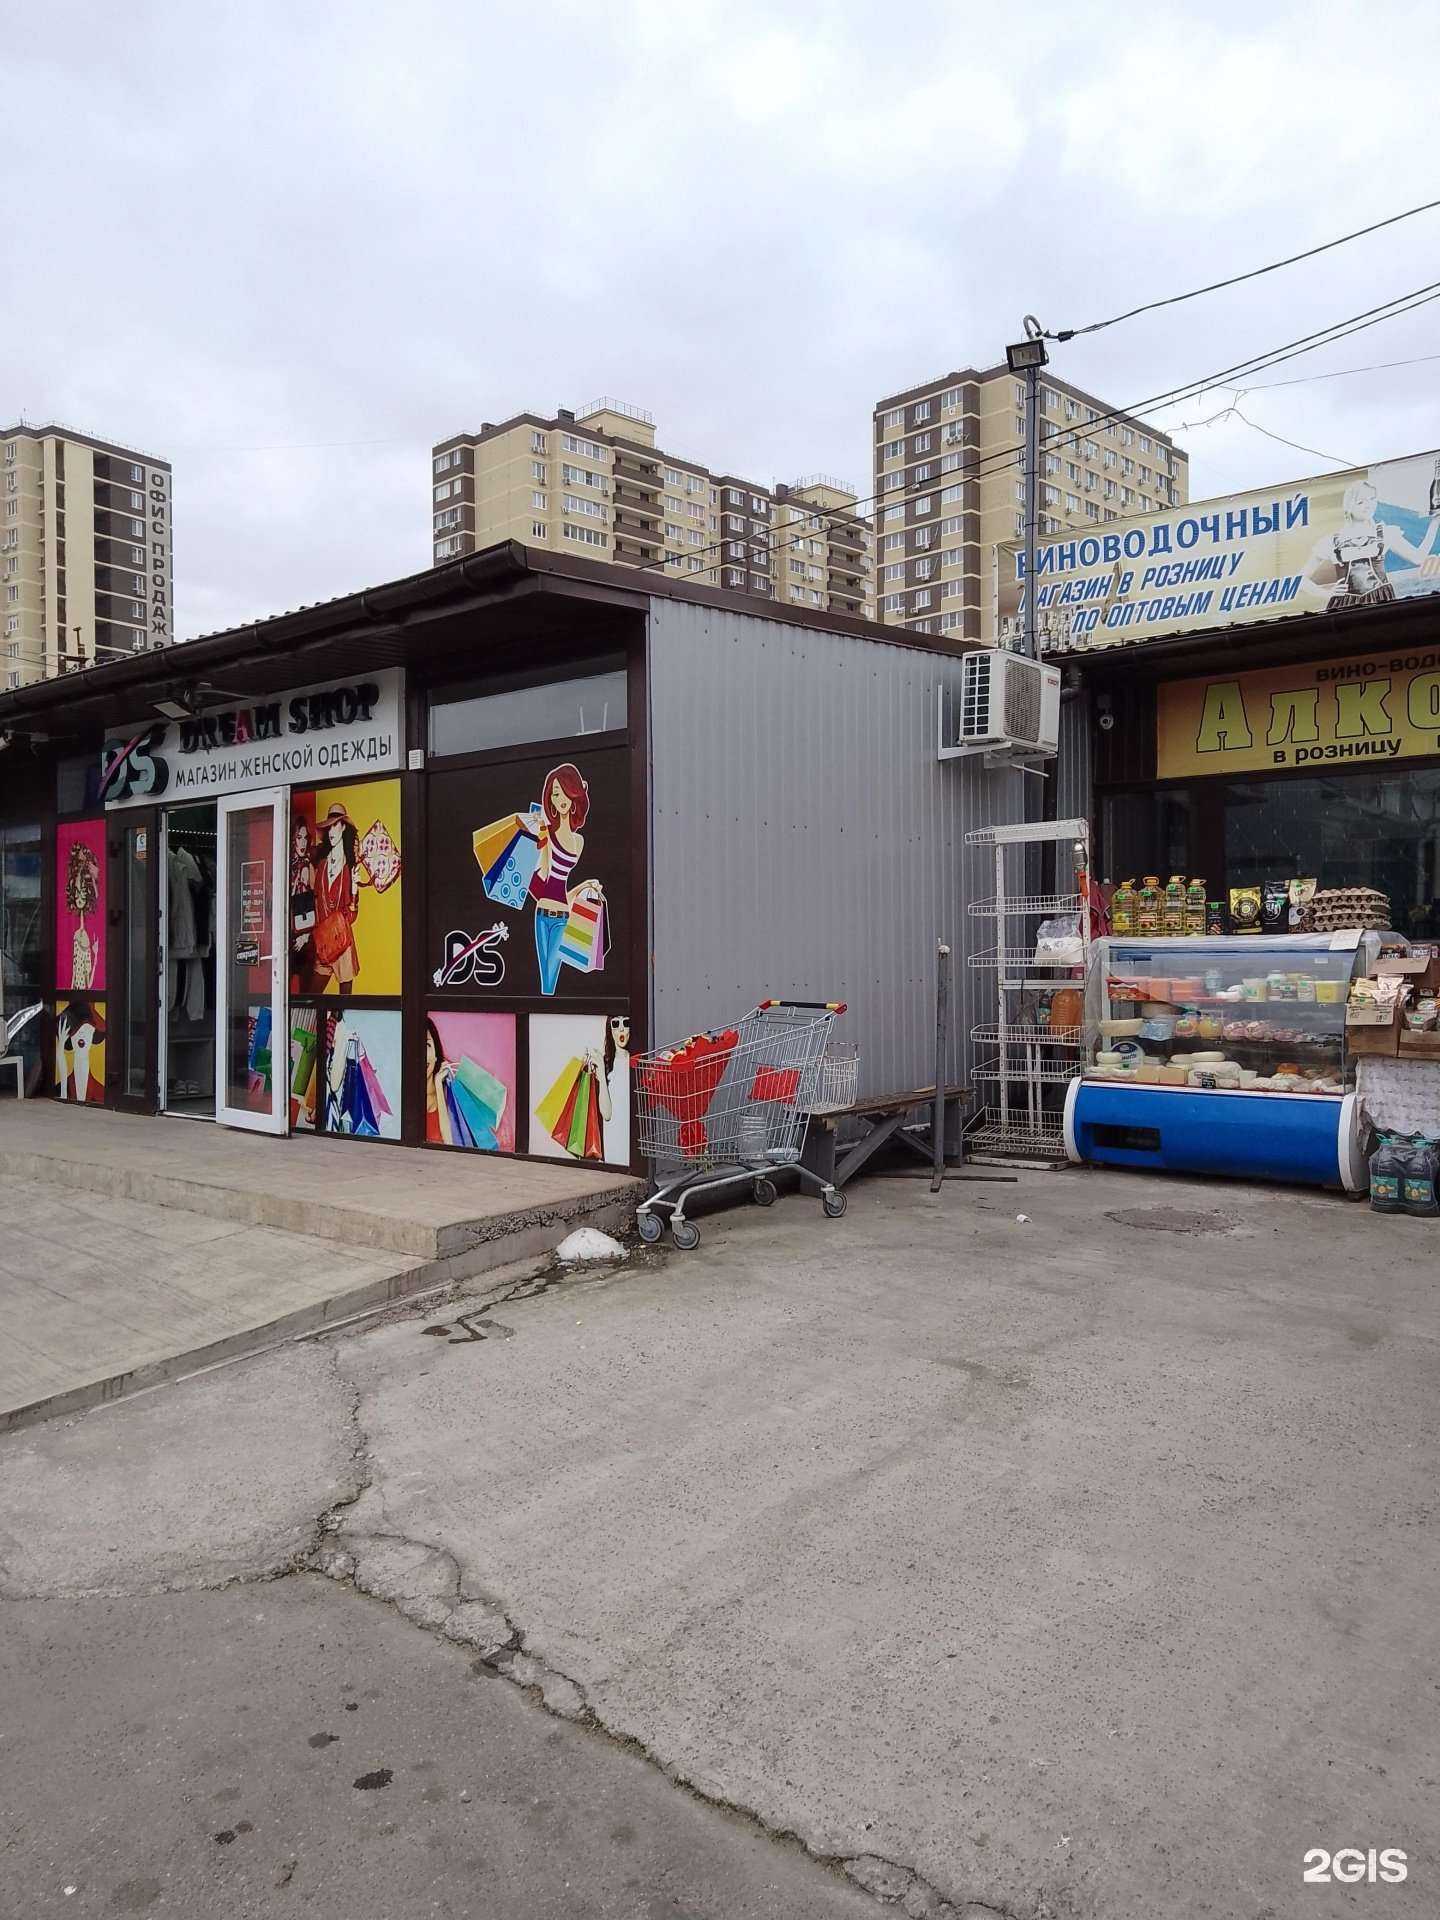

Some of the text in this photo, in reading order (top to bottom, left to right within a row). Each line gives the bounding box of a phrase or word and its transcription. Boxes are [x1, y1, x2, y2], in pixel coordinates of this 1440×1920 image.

[150, 473, 166, 535] ОФИС
[151, 542, 168, 636] ПРОДАЖ
[1117, 571, 1135, 595] В
[1140, 551, 1245, 591] РОЗНИЦУ
[1071, 575, 1303, 634] ПО ОПТОВЫМ ЦЕНАМ
[178, 683, 380, 754] DREAM SHOP
[175, 734, 392, 788] МАГАЗИН ЖЕНСКОЙ ОДЕЖДЫ
[1295, 738, 1402, 765] розницу
[441, 926, 507, 986] DS
